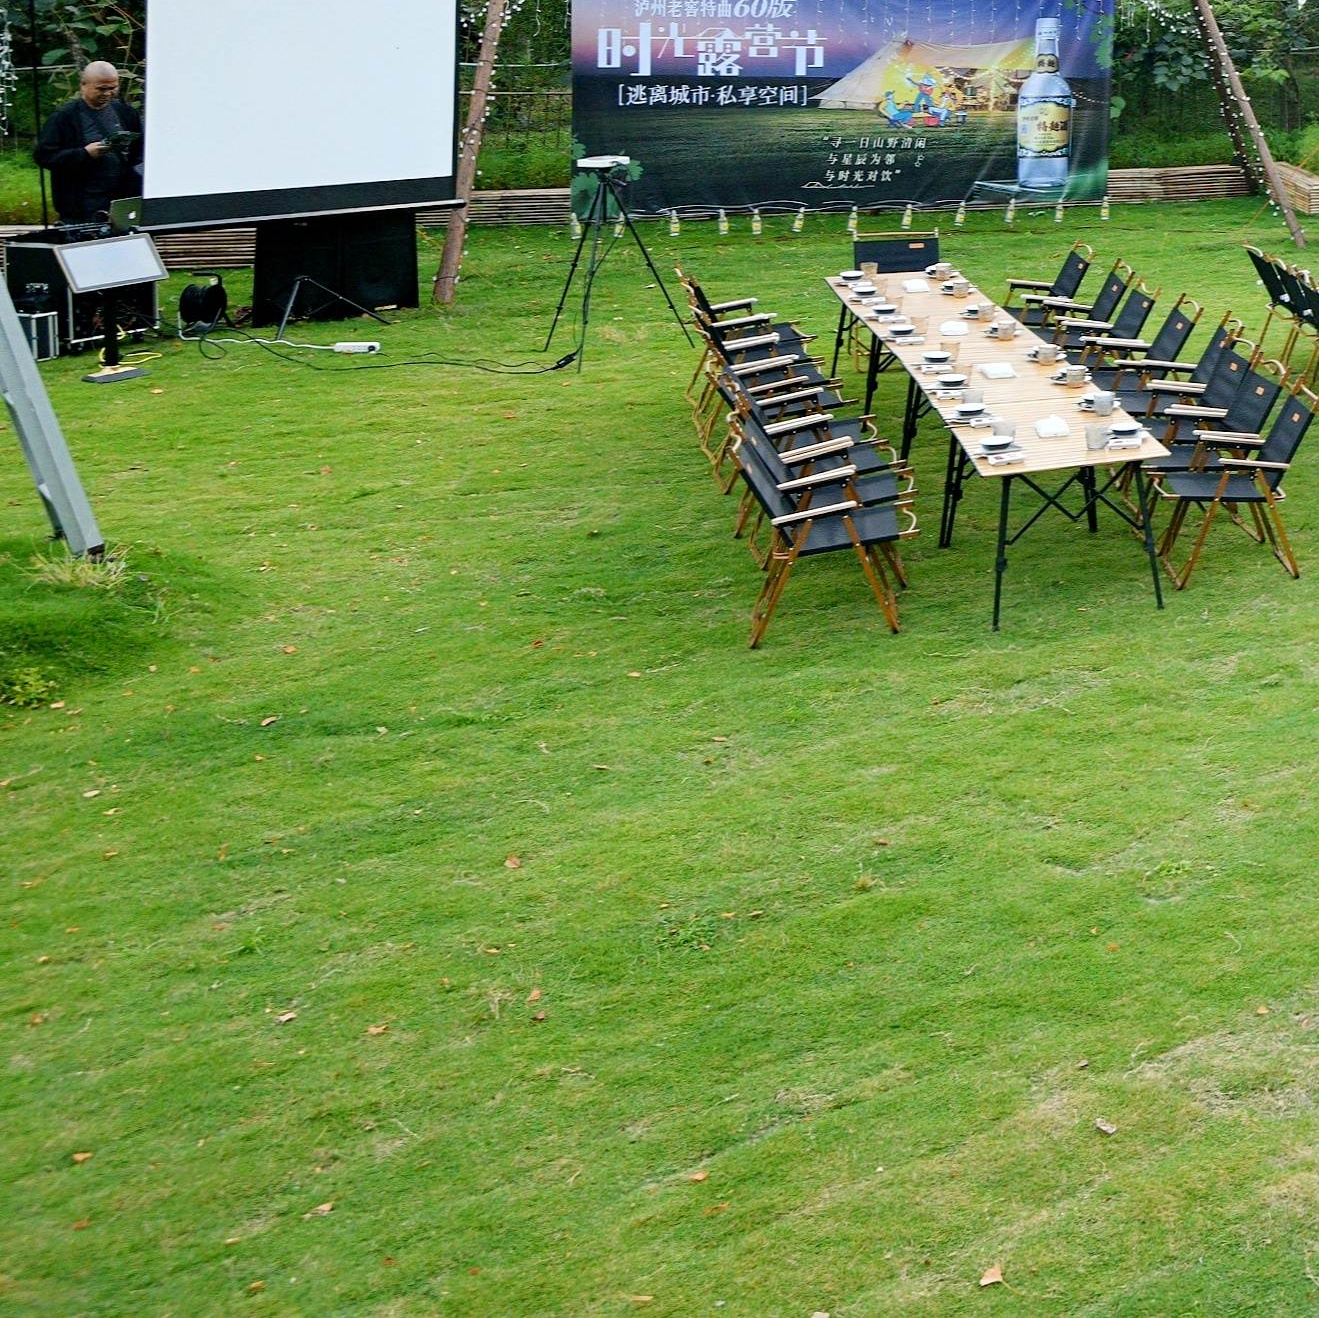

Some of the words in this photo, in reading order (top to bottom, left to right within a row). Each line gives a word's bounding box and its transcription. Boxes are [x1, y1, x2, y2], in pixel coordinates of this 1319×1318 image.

[597, 22, 827, 77] 时光露营节
[826, 153, 897, 165] 与星辰为邻
